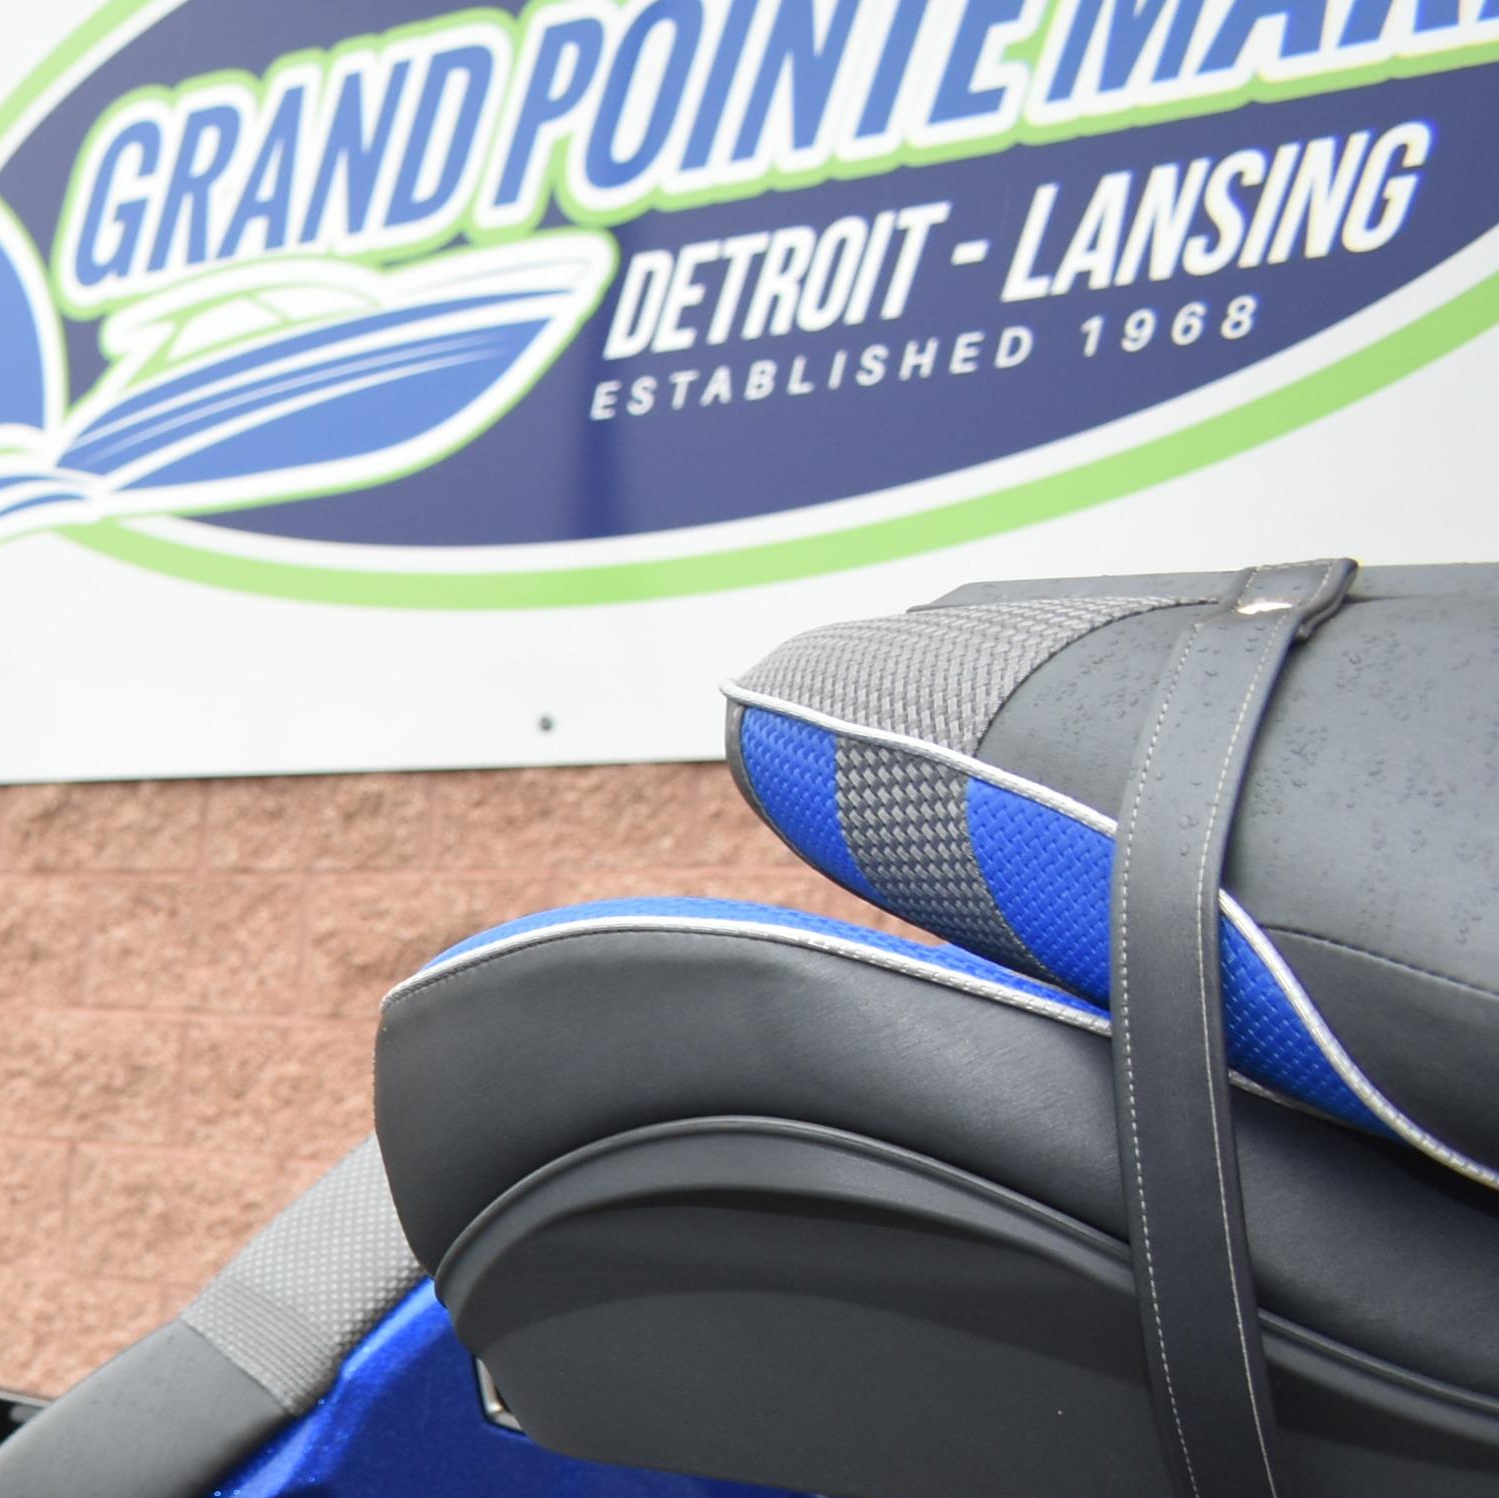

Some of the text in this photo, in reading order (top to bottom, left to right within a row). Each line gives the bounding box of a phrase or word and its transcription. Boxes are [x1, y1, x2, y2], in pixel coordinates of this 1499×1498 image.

[75, 44, 494, 287] GRAND
[493, 0, 1028, 206] POINTE
[603, 121, 1431, 361] DETROIT - LANSING
[589, 294, 1259, 421] ESTABLISHED 1968
